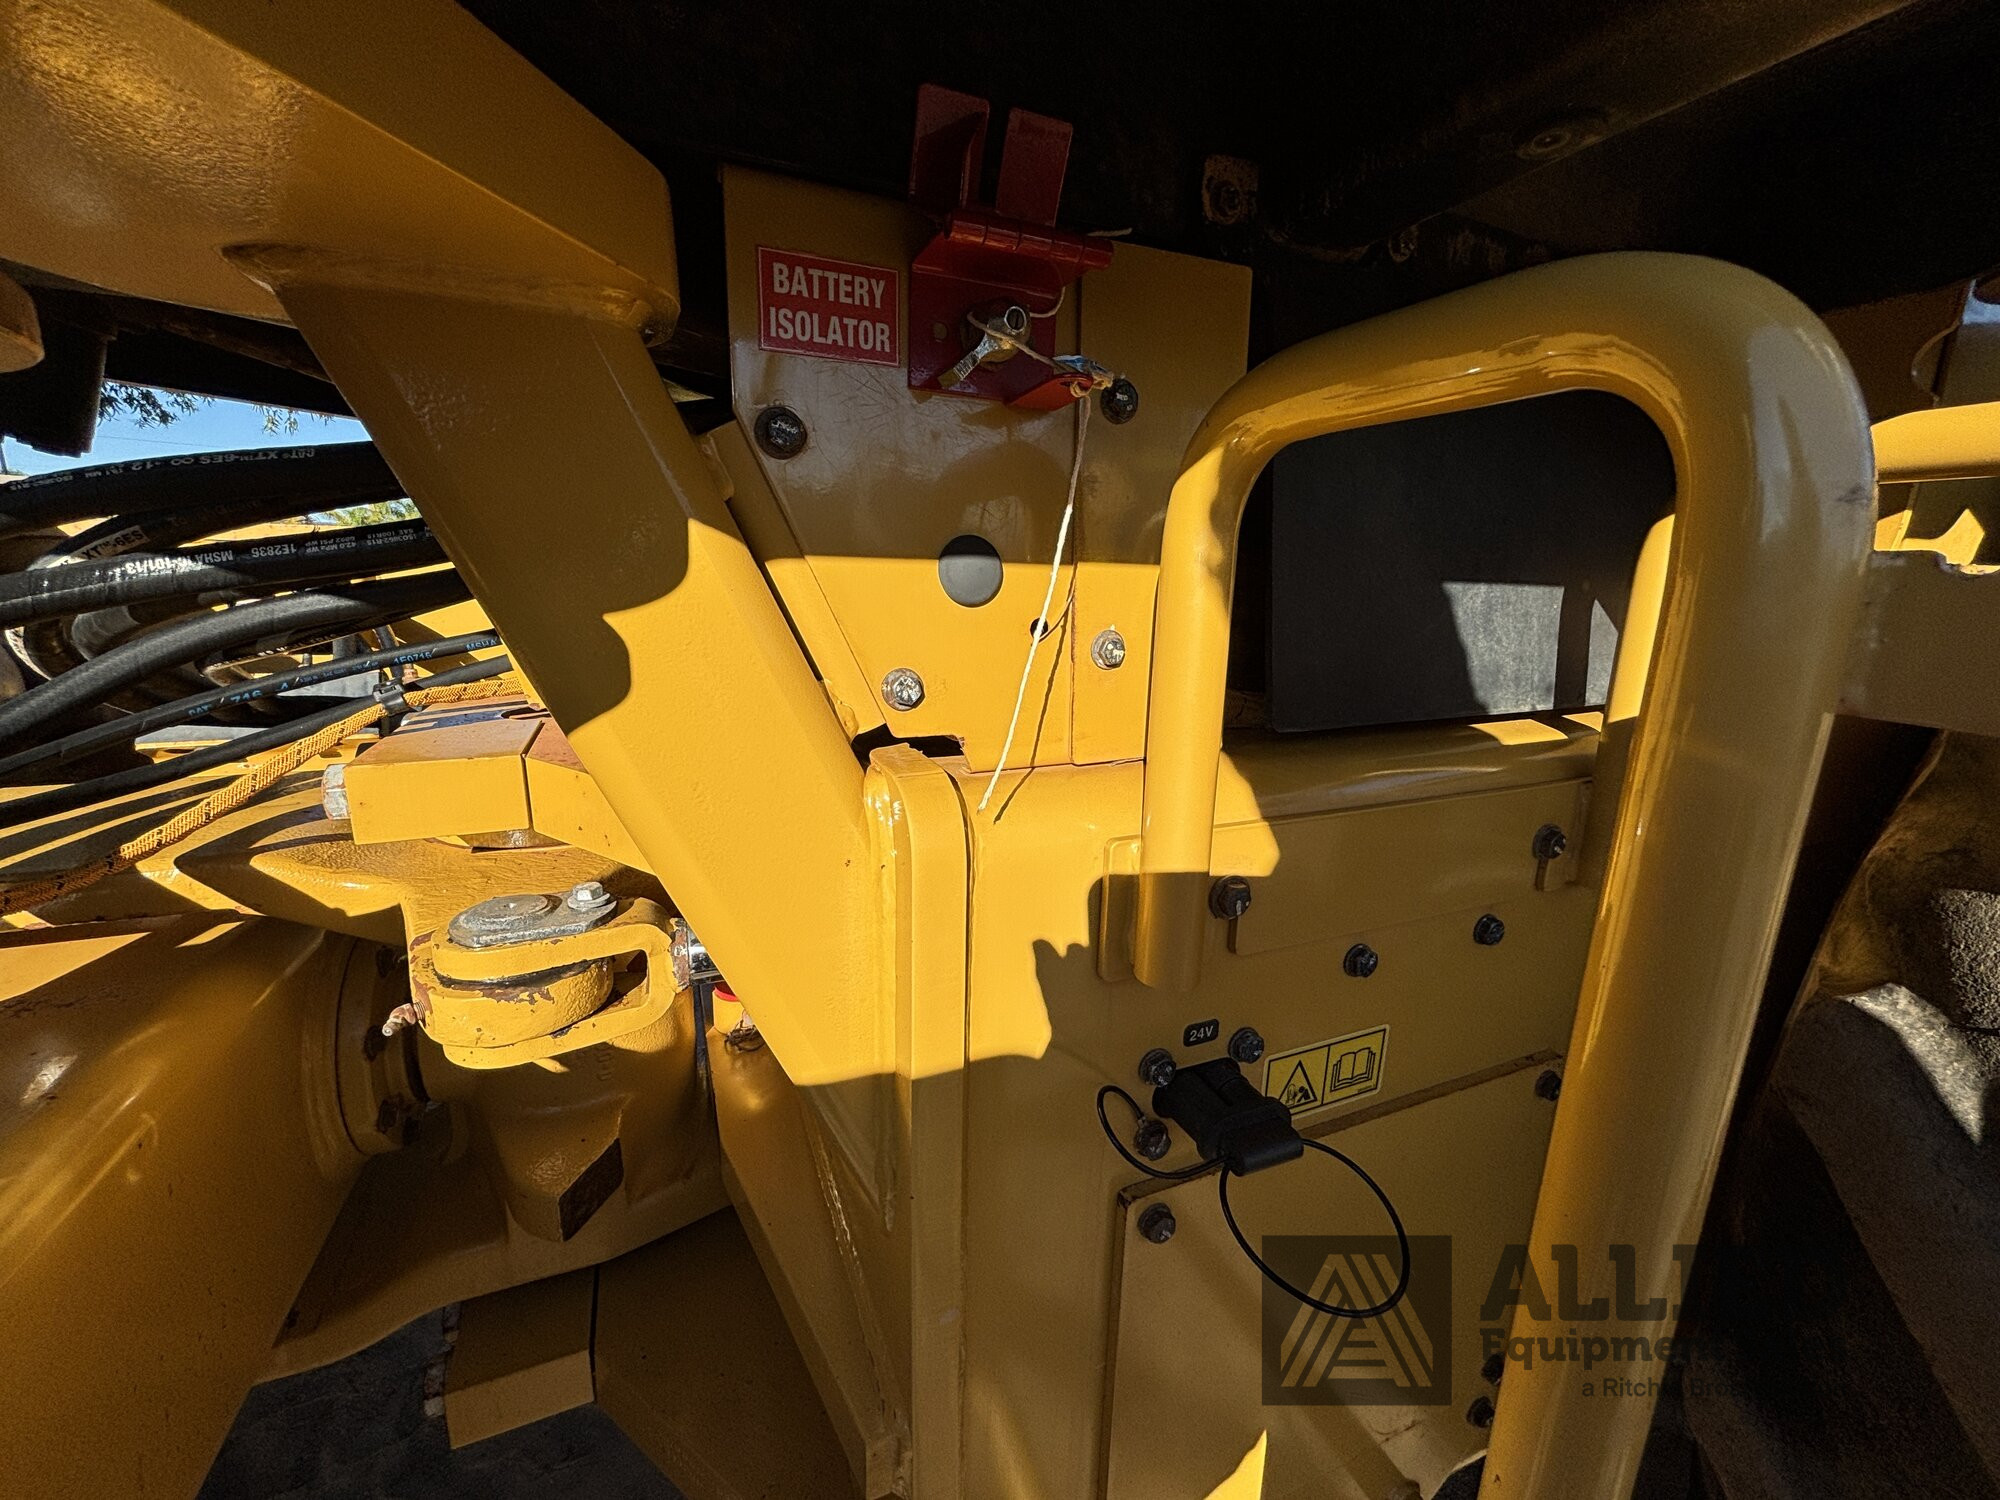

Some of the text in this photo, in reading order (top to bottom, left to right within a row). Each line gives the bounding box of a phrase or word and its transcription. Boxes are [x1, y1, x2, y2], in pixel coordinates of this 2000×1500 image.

[772, 262, 886, 309] BATTERY
[769, 306, 891, 353] ISOLATOR
[1189, 1025, 1214, 1042] 24V
